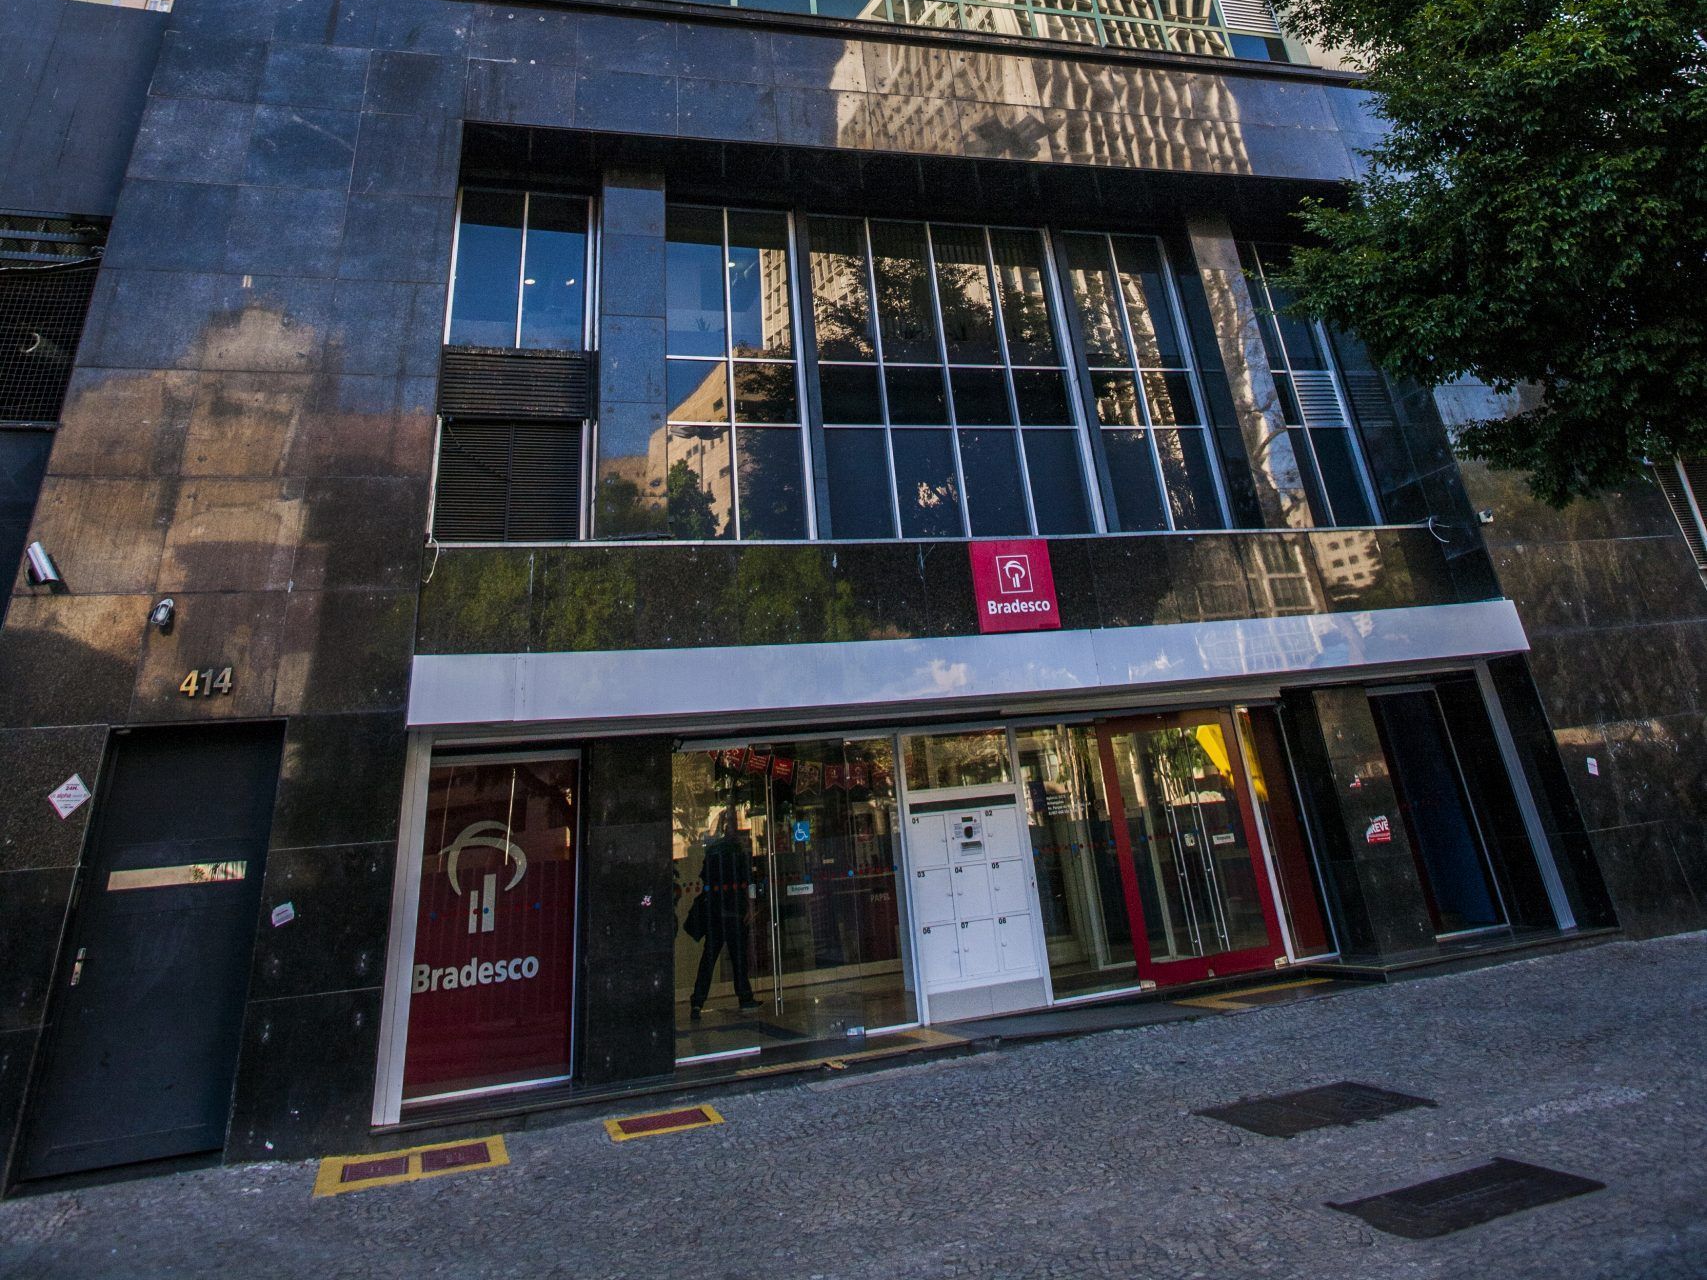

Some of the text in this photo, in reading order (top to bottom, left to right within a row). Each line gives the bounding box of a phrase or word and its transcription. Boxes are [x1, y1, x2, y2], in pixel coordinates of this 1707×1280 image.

[987, 599, 1051, 615] Bradesco
[180, 667, 232, 697] 414
[412, 956, 539, 994] Bradesco
